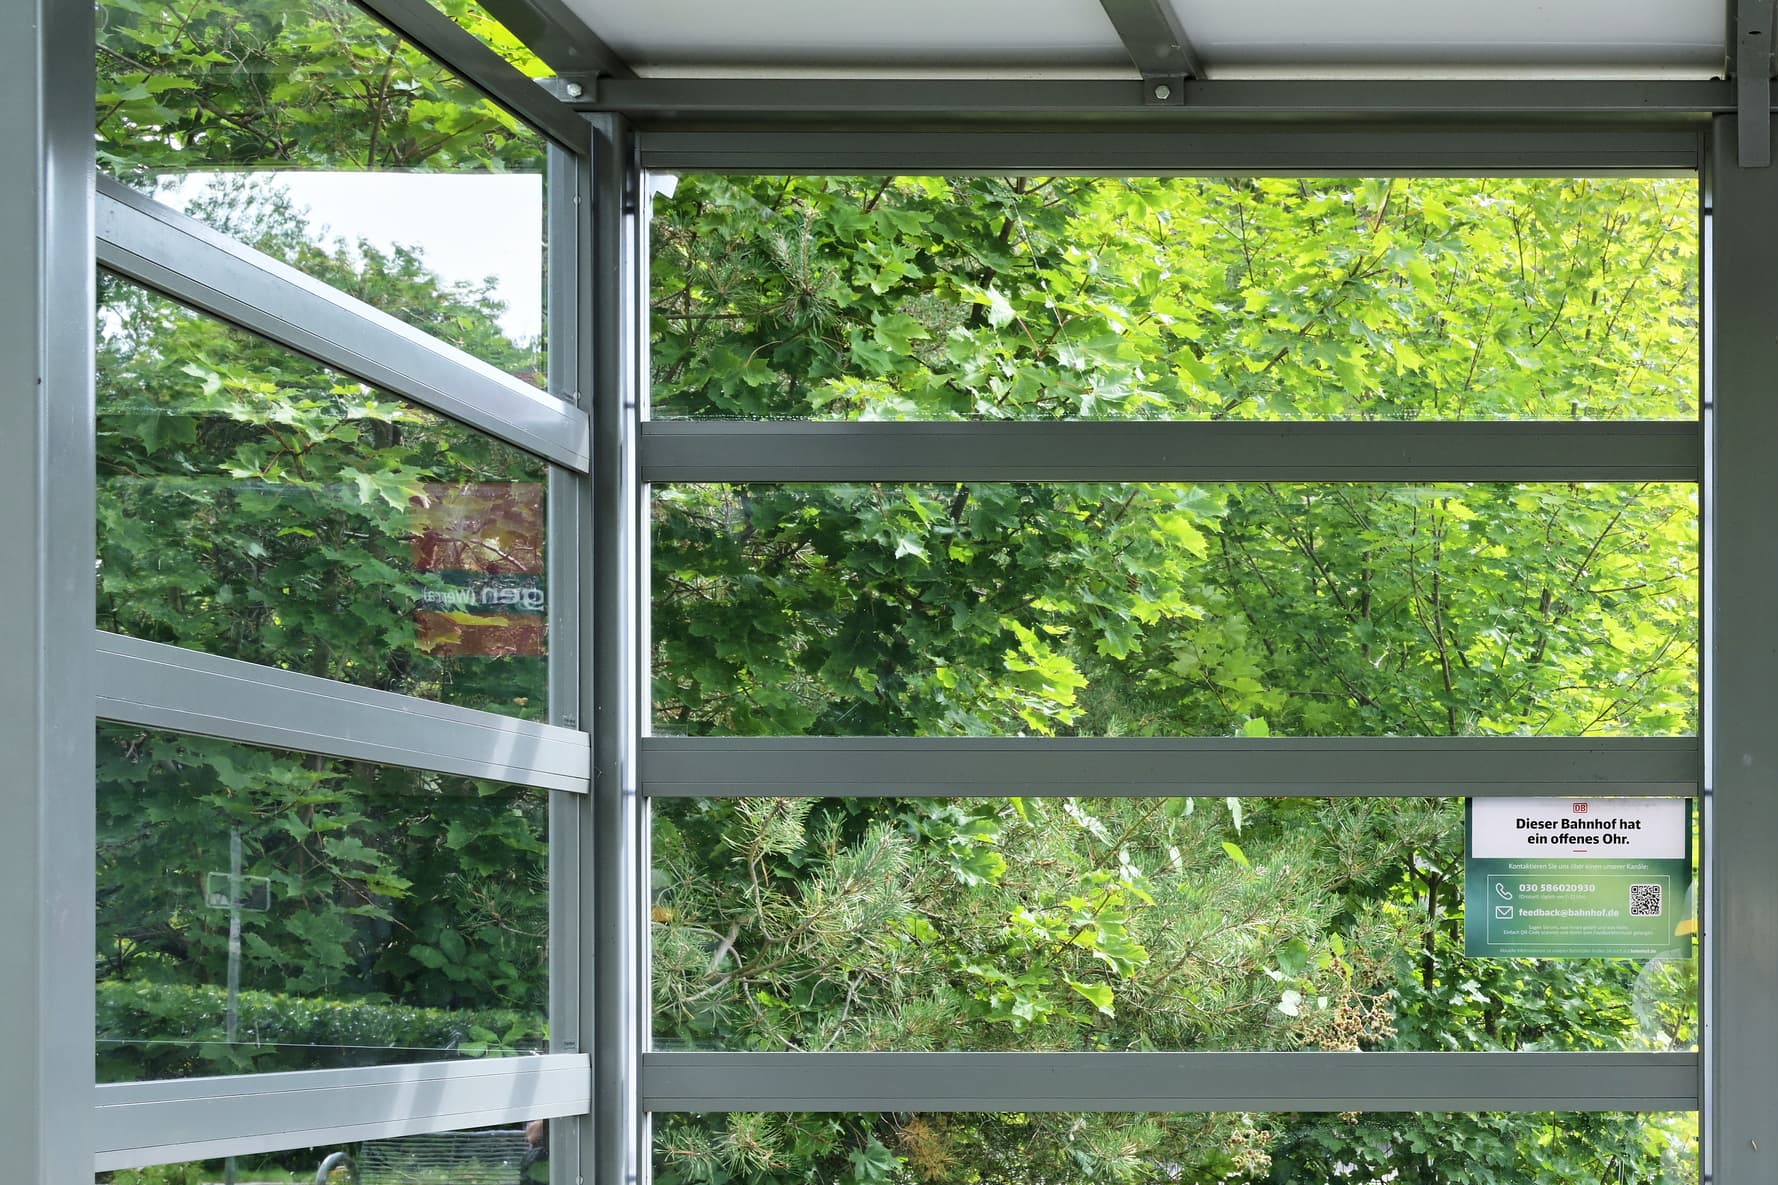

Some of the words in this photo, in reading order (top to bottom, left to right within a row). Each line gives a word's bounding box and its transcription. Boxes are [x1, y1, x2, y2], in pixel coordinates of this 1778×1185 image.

[1573, 804, 1587, 812] DB
[1516, 818, 1557, 829] Dieser
[1561, 818, 1617, 829] Bahnhof
[1620, 818, 1641, 830] hat
[1527, 833, 1548, 844] ein
[1550, 833, 1599, 844] offenes
[1602, 834, 1630, 844] Ohr.
[1519, 884, 1538, 892] 030
[1540, 884, 1596, 892] 586020930
[1518, 908, 1620, 917] feedback@bahnhof.de
